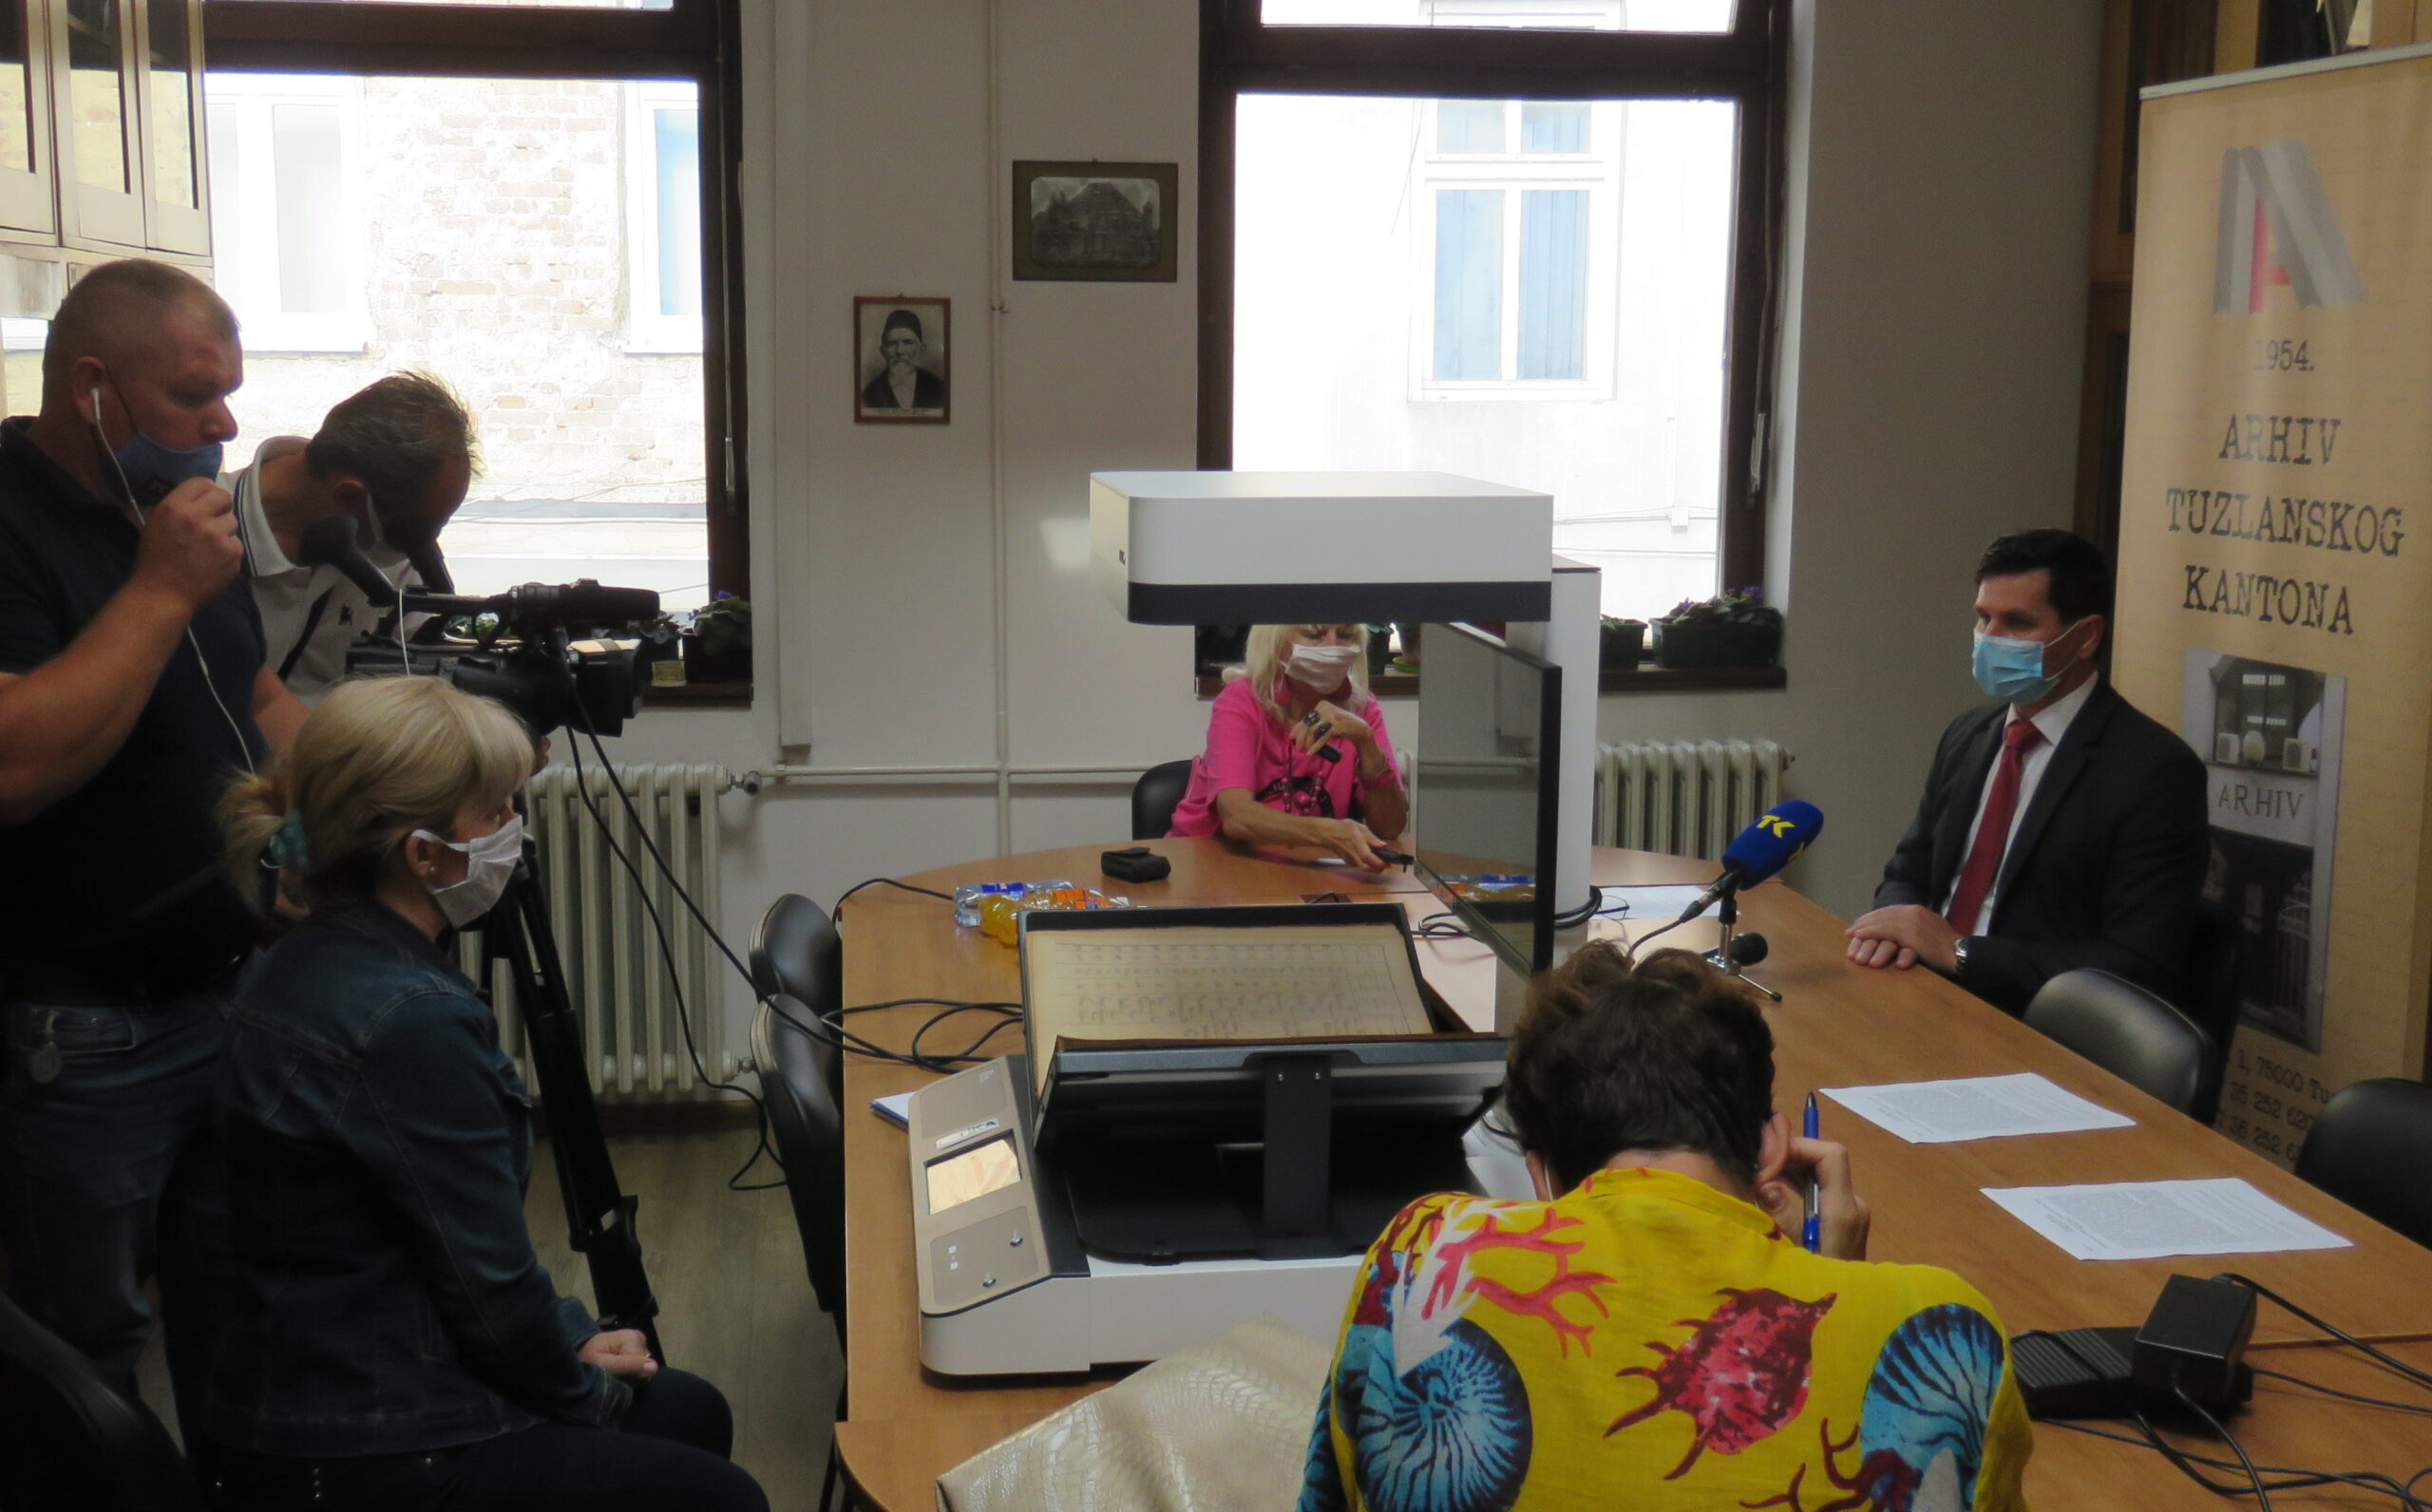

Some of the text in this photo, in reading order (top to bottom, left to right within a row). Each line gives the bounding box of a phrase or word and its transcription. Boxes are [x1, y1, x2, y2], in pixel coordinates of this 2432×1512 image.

[2253, 338, 2315, 371] 1954.
[2218, 413, 2342, 465] ARHIV
[2166, 486, 2405, 558] TUZLANSKOG
[2181, 564, 2354, 635] KANTONA
[2218, 784, 2305, 820] ARHIV
[2230, 1081, 2249, 1105] 35
[2253, 1091, 2282, 1120] 252
[2256, 1055, 2304, 1093] 75000
[2308, 1077, 2340, 1105] Tu
